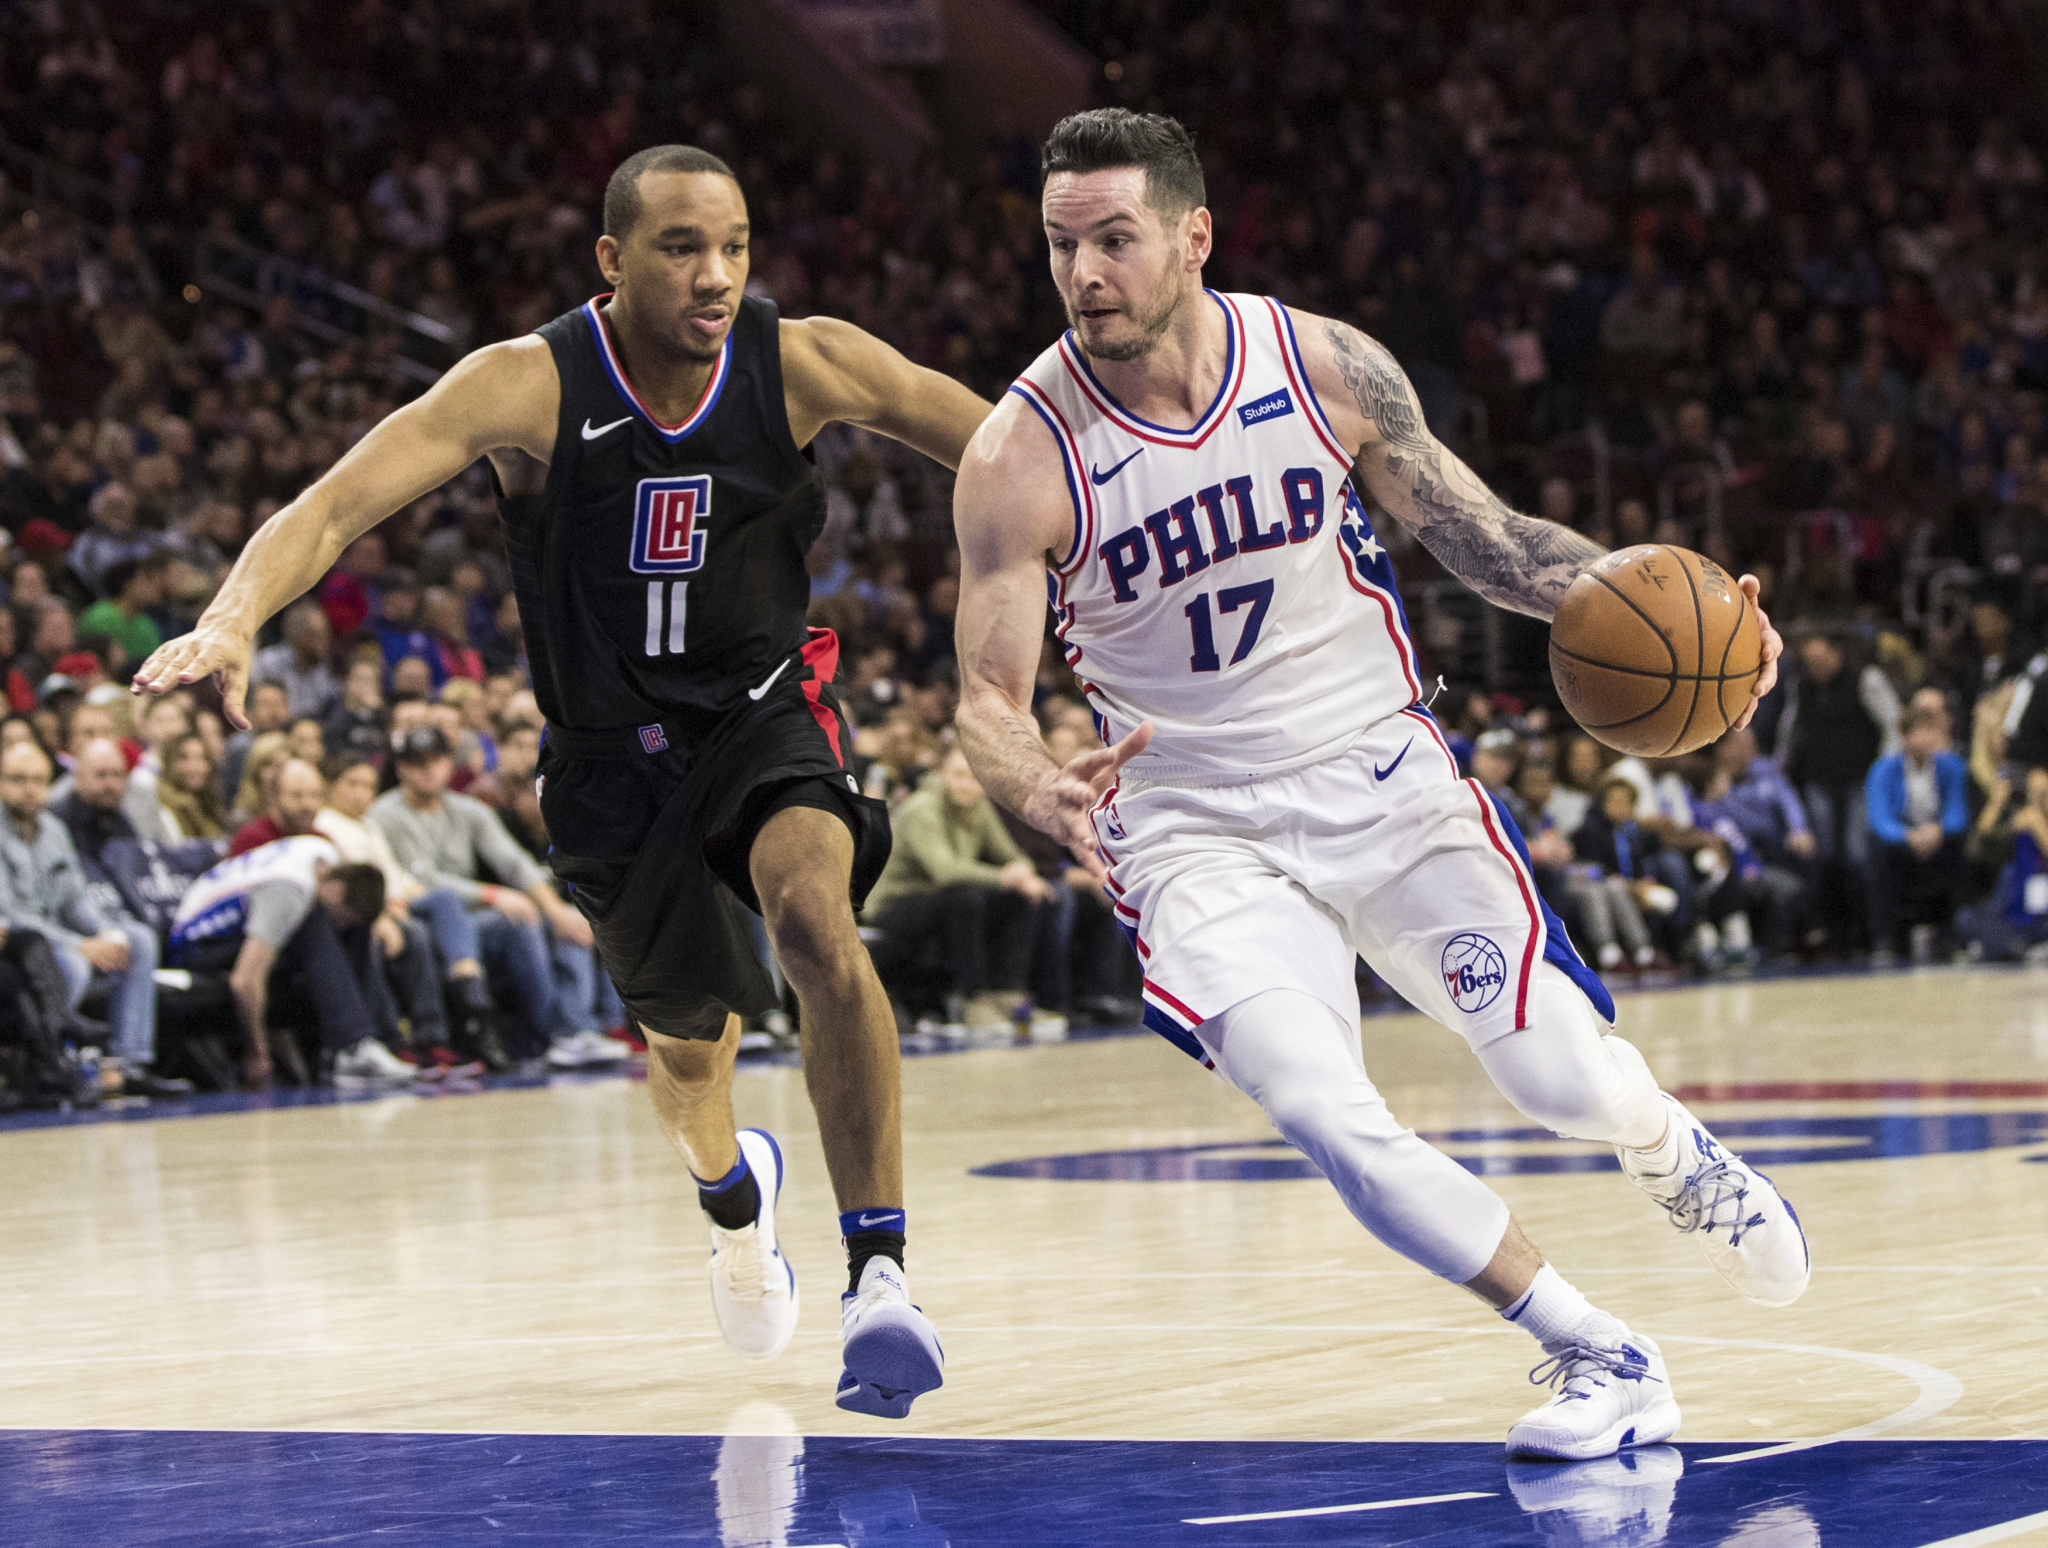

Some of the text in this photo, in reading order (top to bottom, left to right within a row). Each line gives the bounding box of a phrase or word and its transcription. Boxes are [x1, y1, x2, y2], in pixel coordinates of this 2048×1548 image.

[1244, 399, 1286, 420] StubHub
[1098, 467, 1325, 604] PHILA
[646, 581, 689, 656] 11
[1185, 578, 1274, 672] 17
[1445, 964, 1502, 999] 76ers
